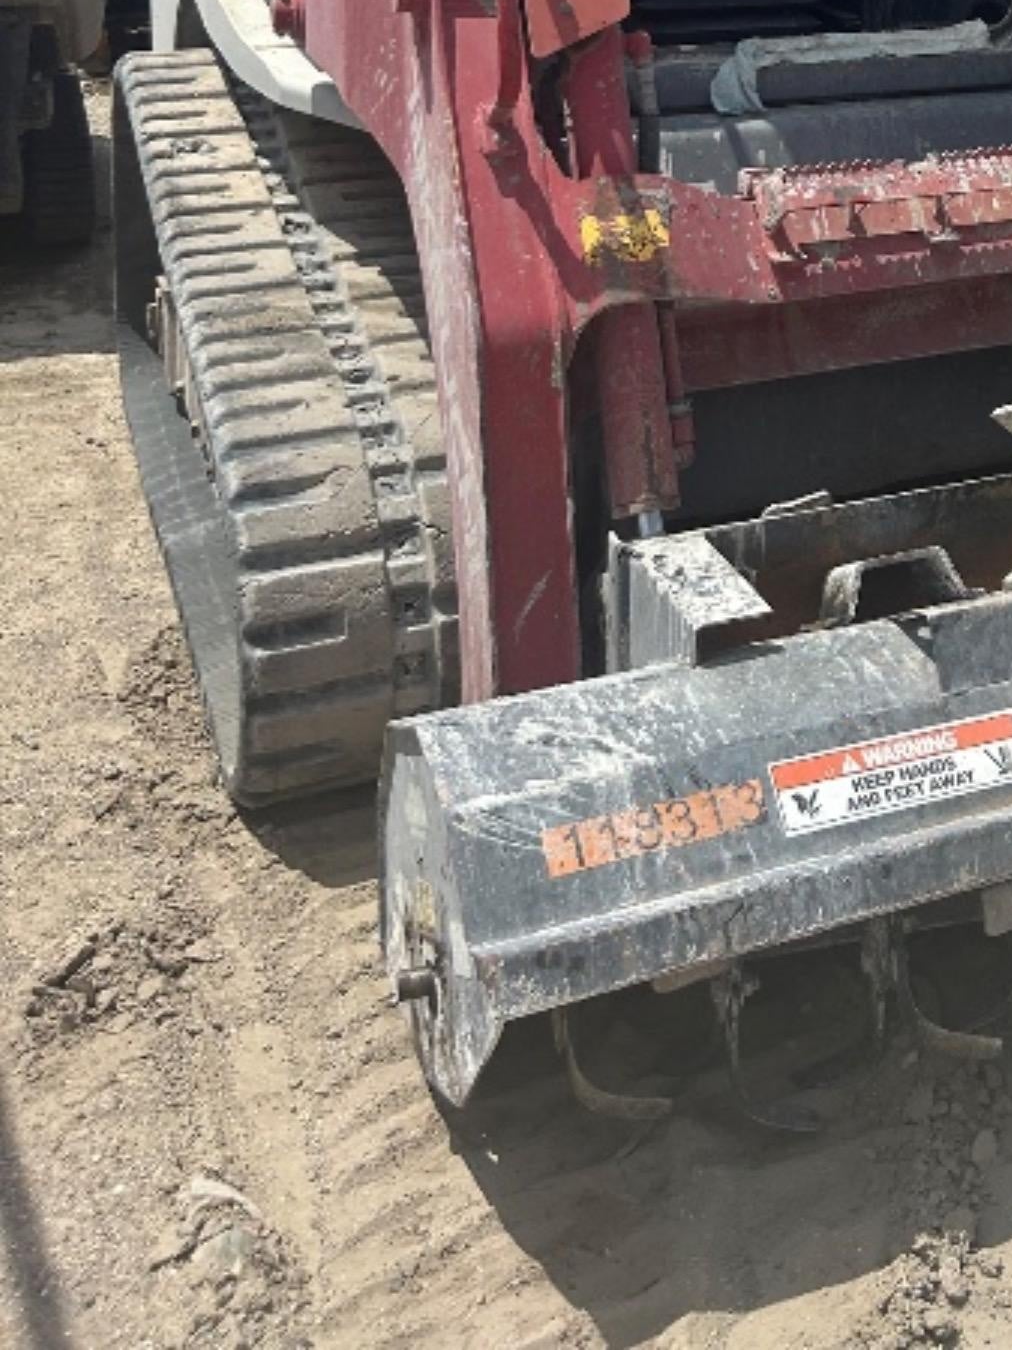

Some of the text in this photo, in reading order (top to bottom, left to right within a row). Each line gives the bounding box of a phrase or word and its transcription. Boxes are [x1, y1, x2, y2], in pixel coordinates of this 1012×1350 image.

[861, 731, 959, 768] WARNING
[847, 769, 975, 811] AND FEET AWAY
[851, 756, 957, 792] KEEP HANDS
